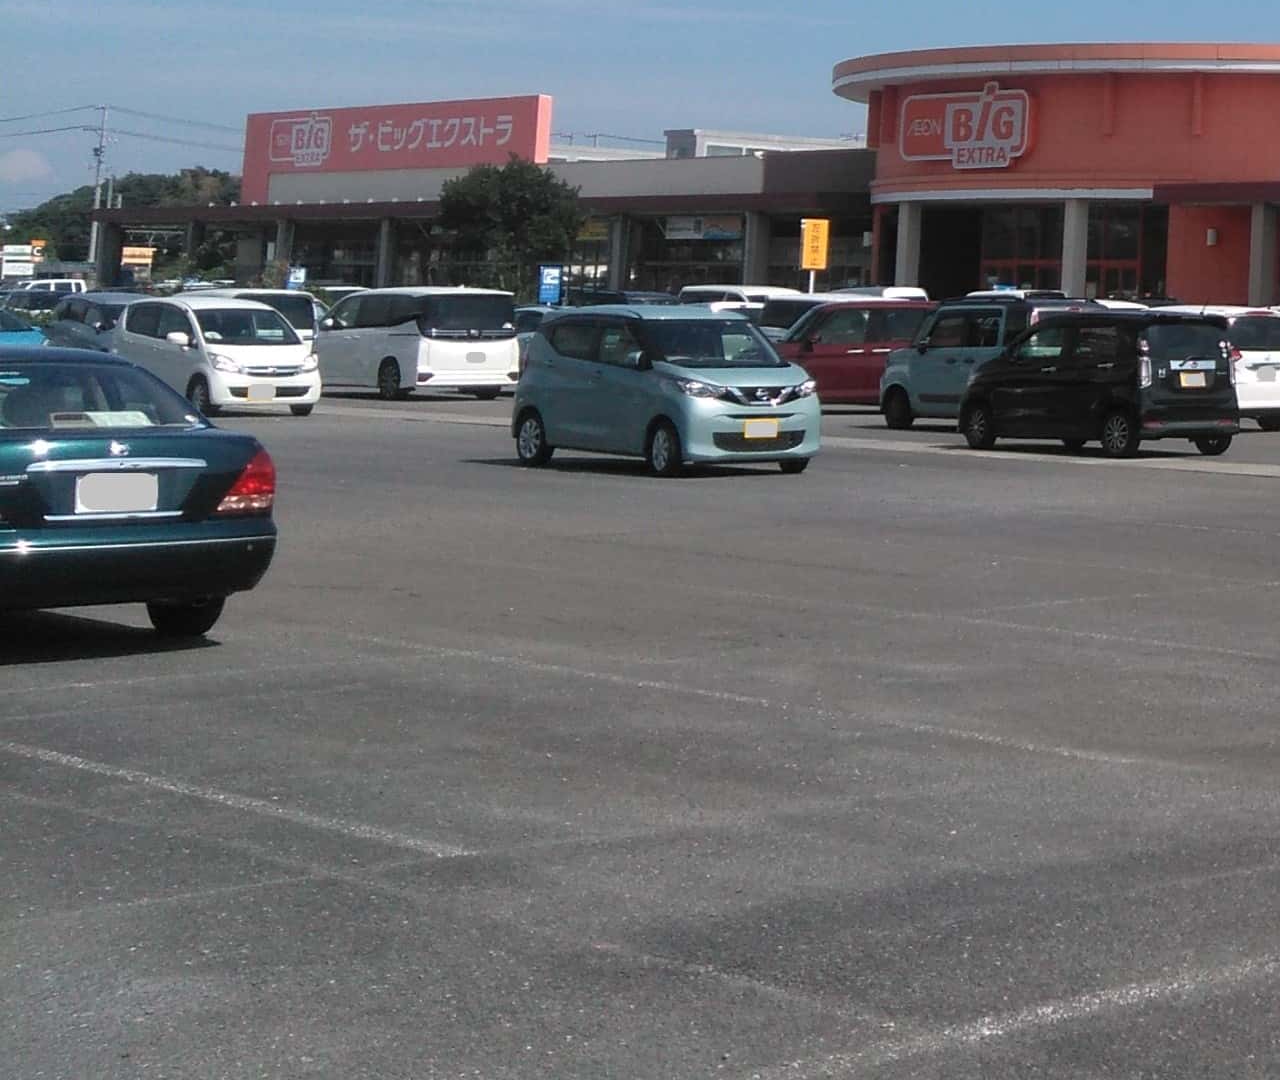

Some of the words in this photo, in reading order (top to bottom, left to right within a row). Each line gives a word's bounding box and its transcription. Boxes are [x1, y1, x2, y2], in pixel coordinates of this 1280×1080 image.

[348, 115, 513, 153] ザ・ビッグエクストラ
[956, 147, 1008, 164] EXTRA
